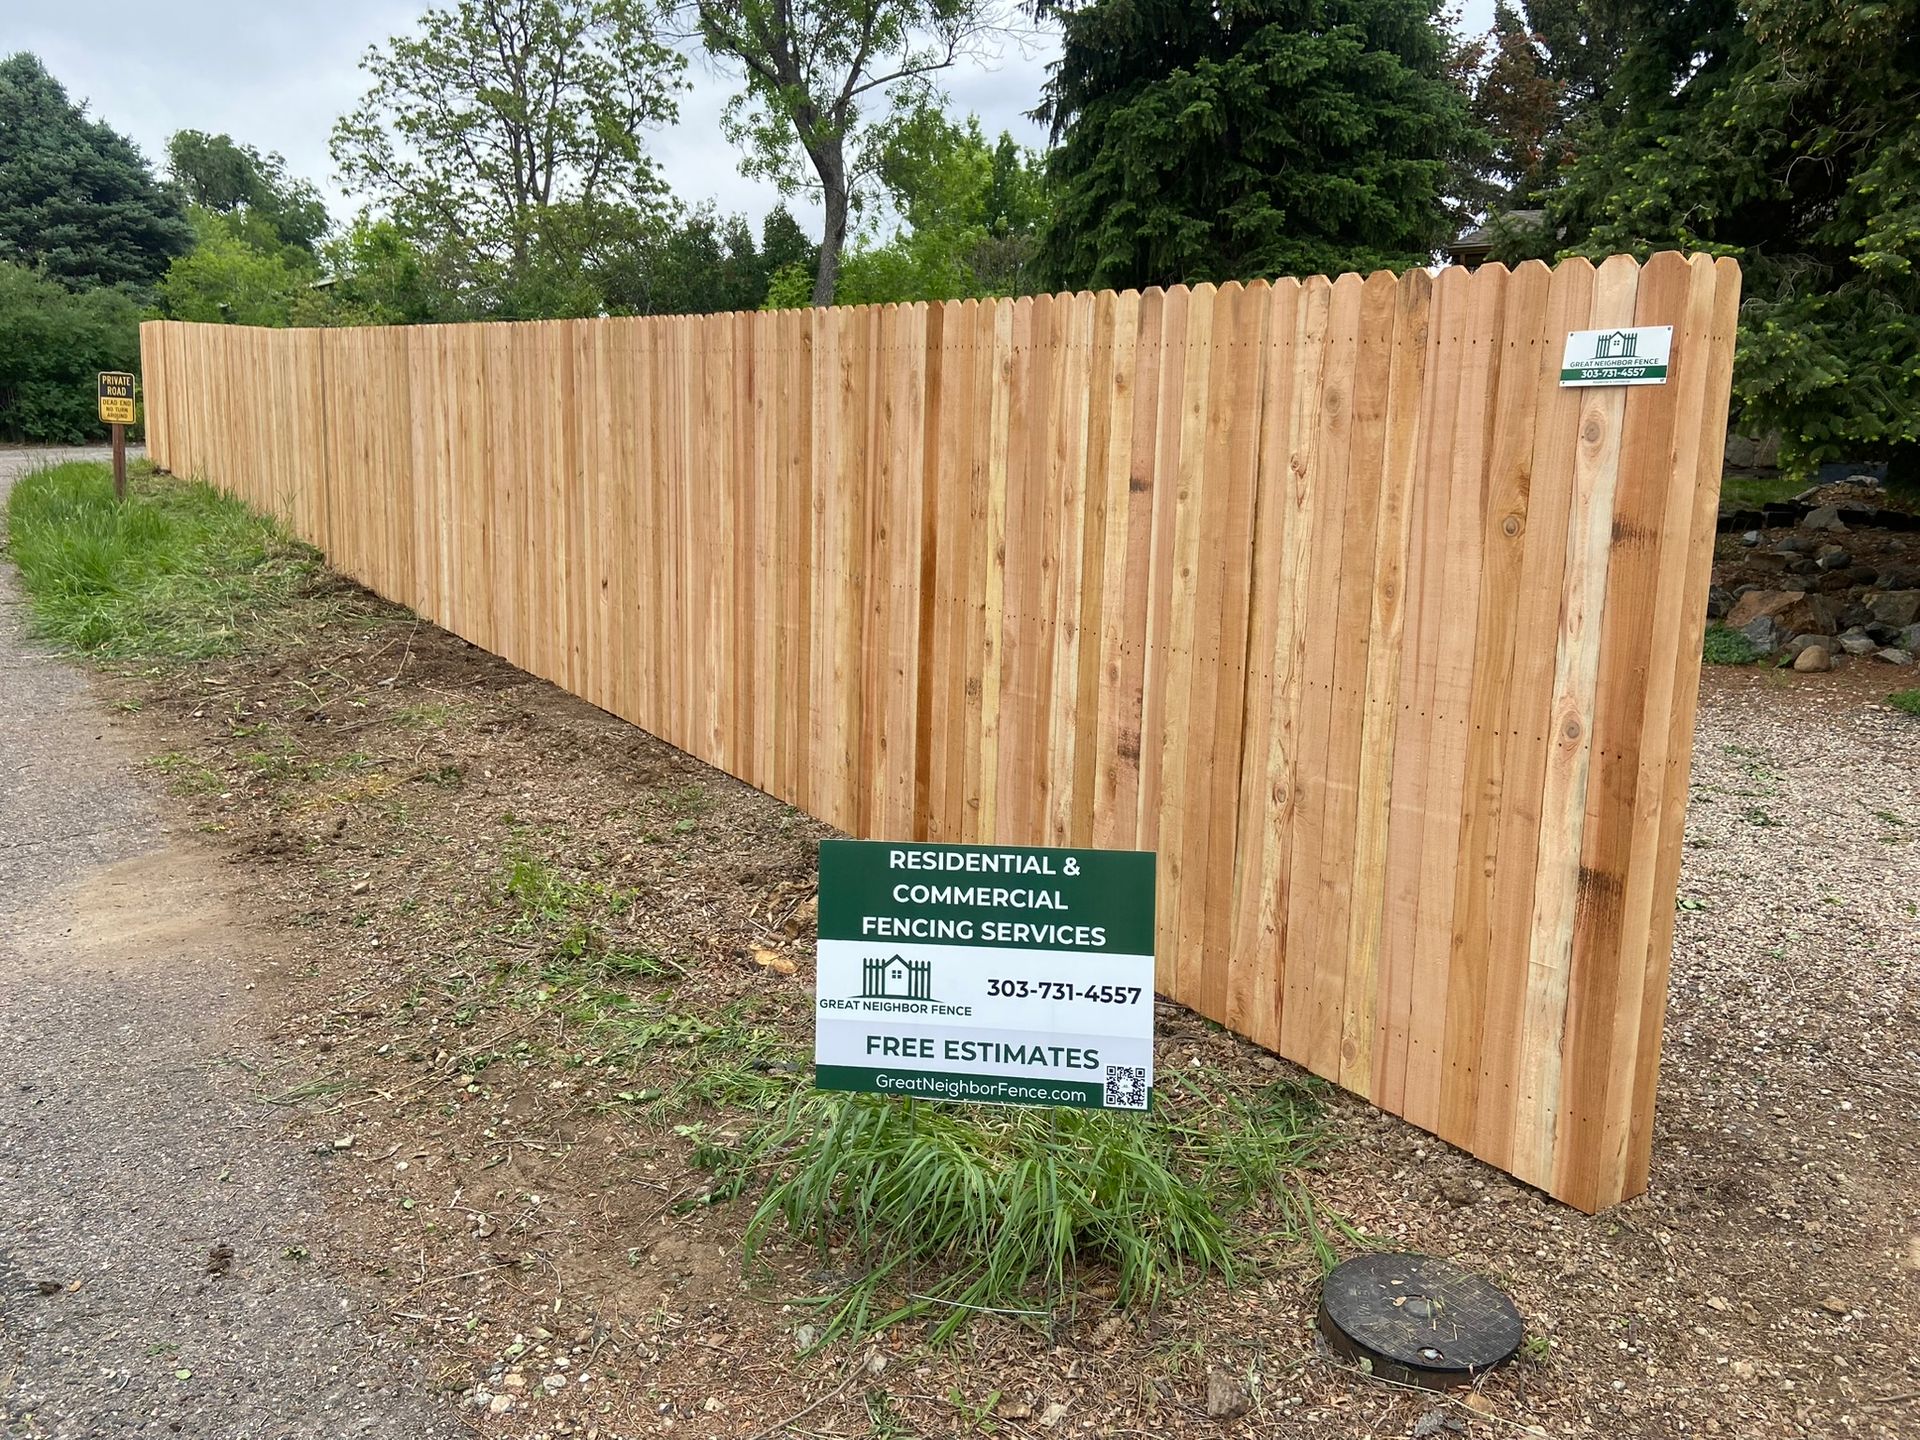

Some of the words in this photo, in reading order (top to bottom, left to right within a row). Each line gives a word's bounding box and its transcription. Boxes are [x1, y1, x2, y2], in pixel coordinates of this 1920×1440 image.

[1581, 368, 1646, 379] 303-731-4557
[1595, 359, 1633, 367] NEIGHBOR
[102, 375, 131, 386] PRIVATE
[107, 386, 127, 396] ROAD
[889, 850, 1056, 875] RESIDENTIAL
[1063, 857, 1081, 876] &
[892, 884, 1069, 910] COMMERCIAL
[862, 916, 974, 940] FENCING
[981, 921, 1106, 946] SERVICES
[987, 979, 1142, 1005] 303-731-4557
[819, 998, 861, 1010] GREAT
[863, 1000, 928, 1014] NEIGHBOR
[931, 1004, 972, 1016] FENCE
[866, 1035, 935, 1058] FREE
[944, 1040, 1100, 1070] ESTIMATES
[875, 1073, 1086, 1102] GreatNeighborFence.com
